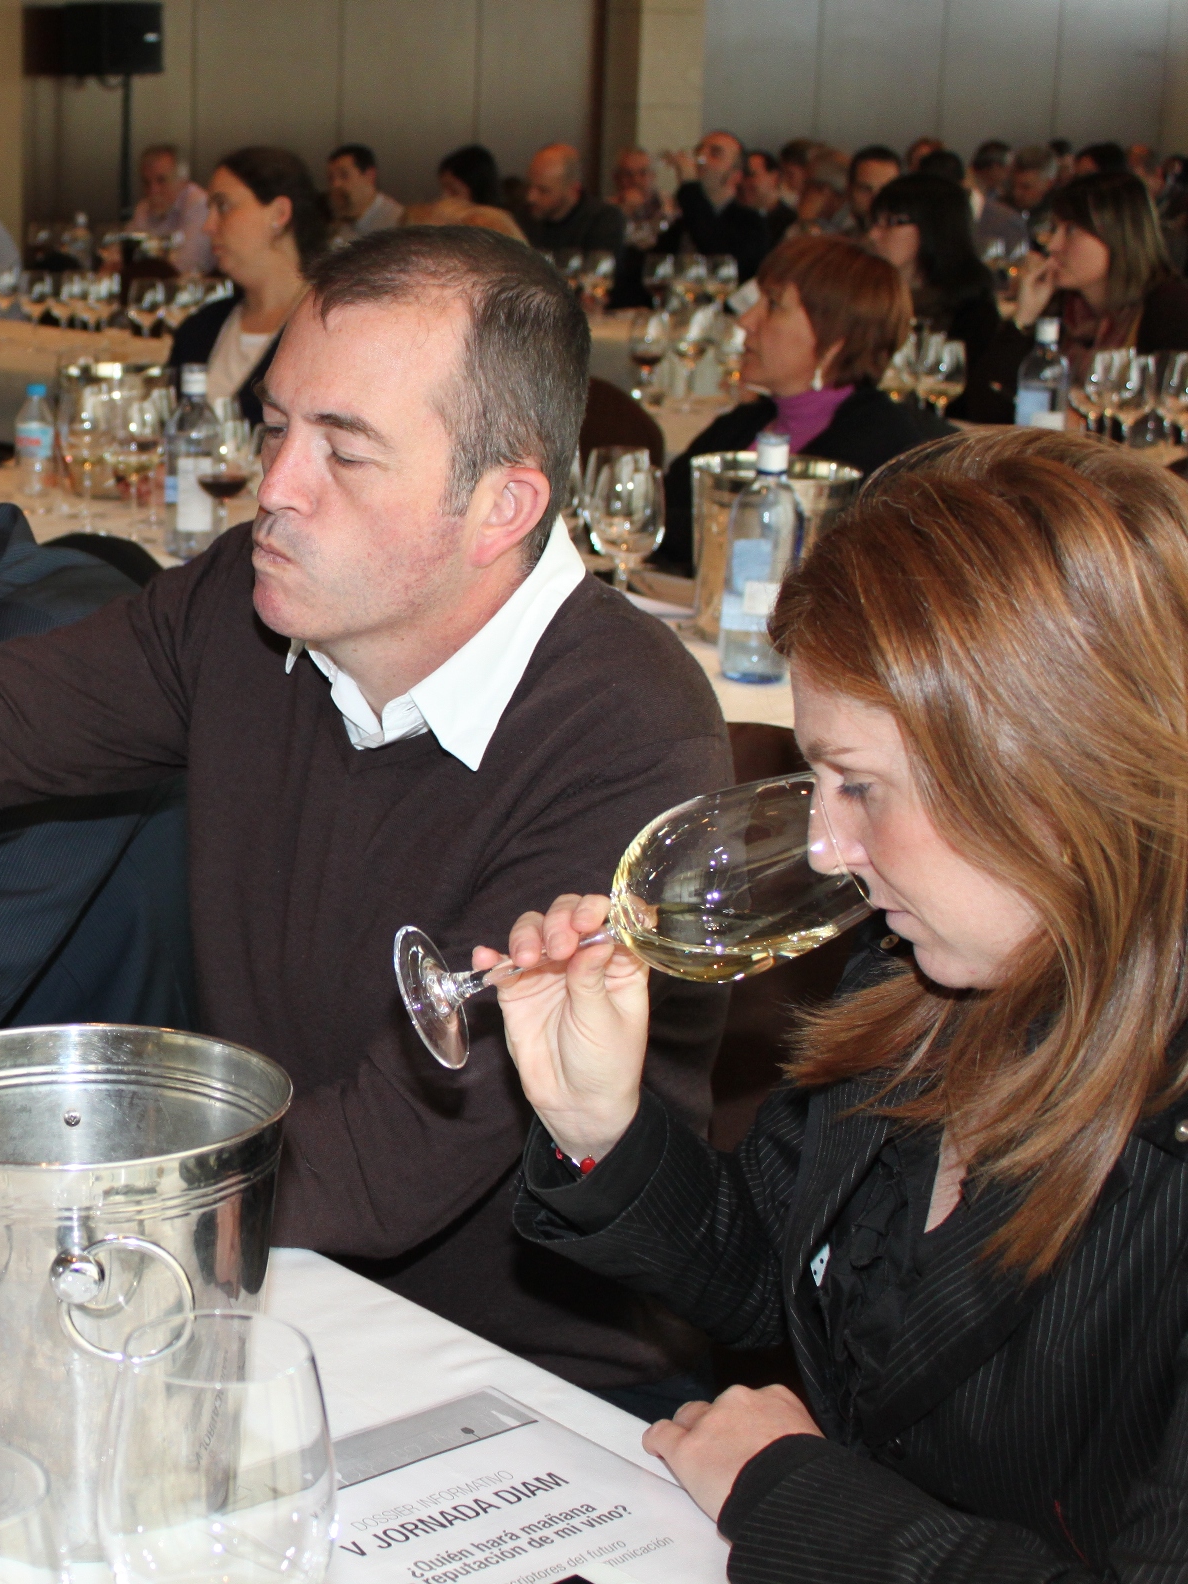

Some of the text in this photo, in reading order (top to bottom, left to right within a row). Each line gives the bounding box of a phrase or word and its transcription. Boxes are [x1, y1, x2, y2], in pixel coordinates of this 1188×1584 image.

[338, 1540, 368, 1558] V
[371, 1497, 502, 1550] JORNADA
[492, 1471, 570, 1506] DIAM
[350, 1503, 421, 1533] DOSSIER
[416, 1469, 514, 1509] INFORMATIVO
[407, 1503, 598, 1579] ¿Quién hará mañana
[421, 1504, 632, 1584] reputación de mi vino?
[566, 1554, 588, 1568] del
[586, 1540, 627, 1561] futuro
